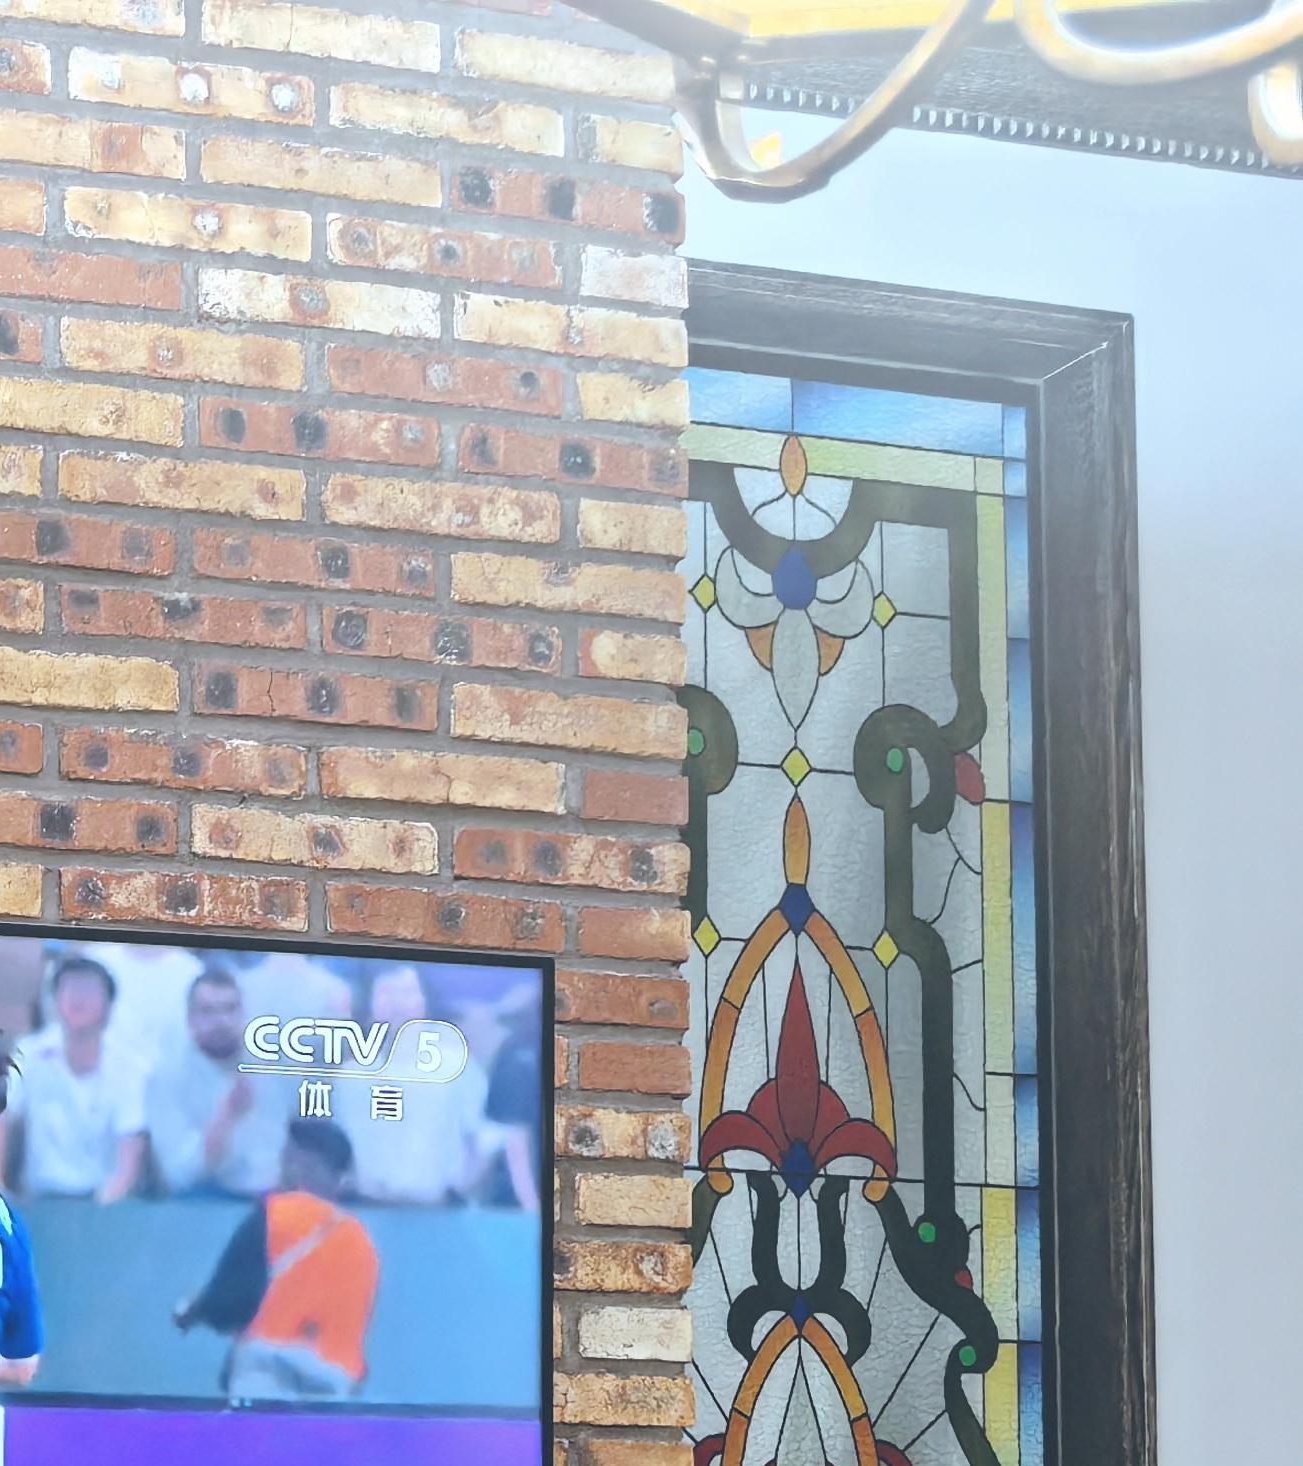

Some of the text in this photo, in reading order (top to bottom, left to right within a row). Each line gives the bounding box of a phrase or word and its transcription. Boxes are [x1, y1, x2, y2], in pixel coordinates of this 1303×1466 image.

[244, 1016, 442, 1073] CCTV 5
[298, 1080, 403, 1121] 体育
